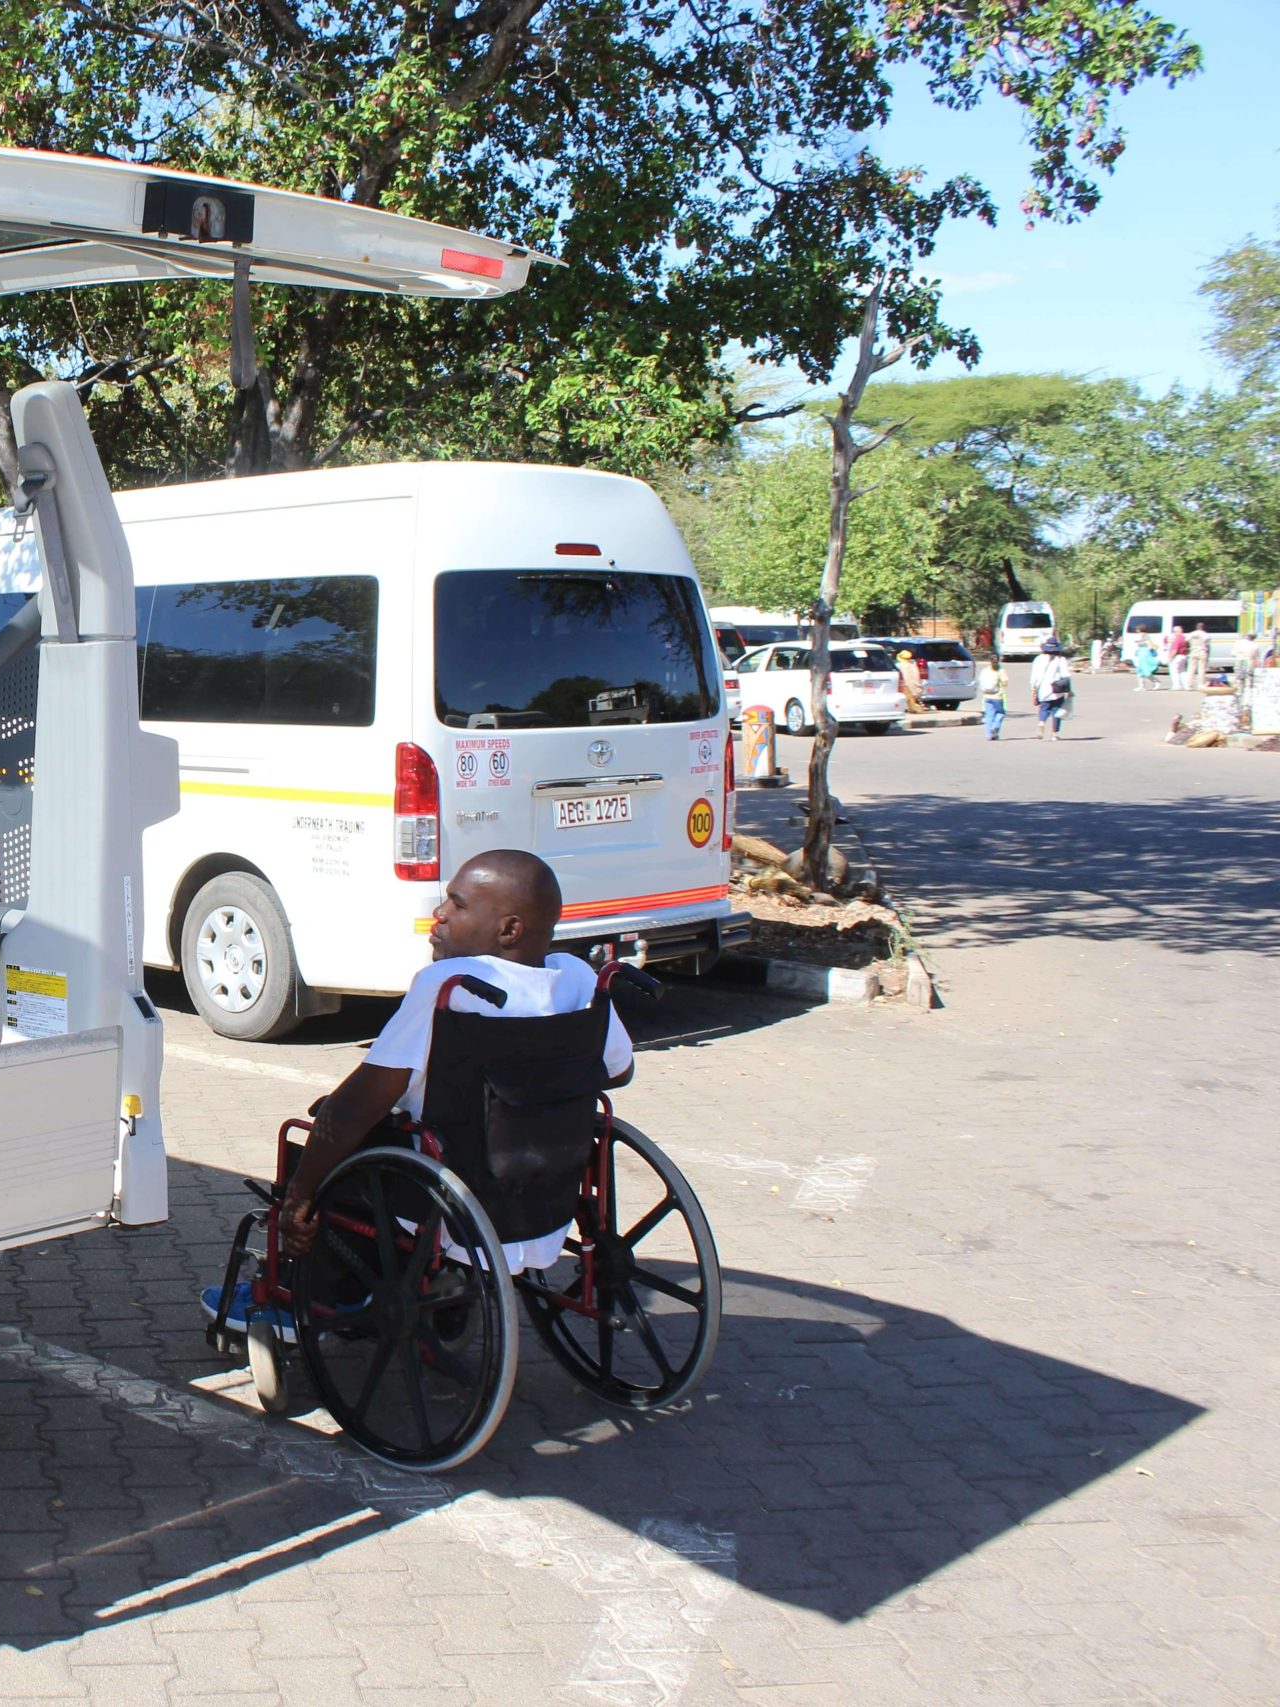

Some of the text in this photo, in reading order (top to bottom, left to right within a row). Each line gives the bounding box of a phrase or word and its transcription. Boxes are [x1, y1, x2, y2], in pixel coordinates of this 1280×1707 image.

[455, 738, 510, 749] MAXIMUM SPEEDS
[461, 755, 473, 772] 80
[493, 753, 505, 770] 60
[560, 797, 628, 824] AEG 1275
[292, 816, 365, 834] UNDERNEATH TRADING
[692, 813, 711, 833] 100
